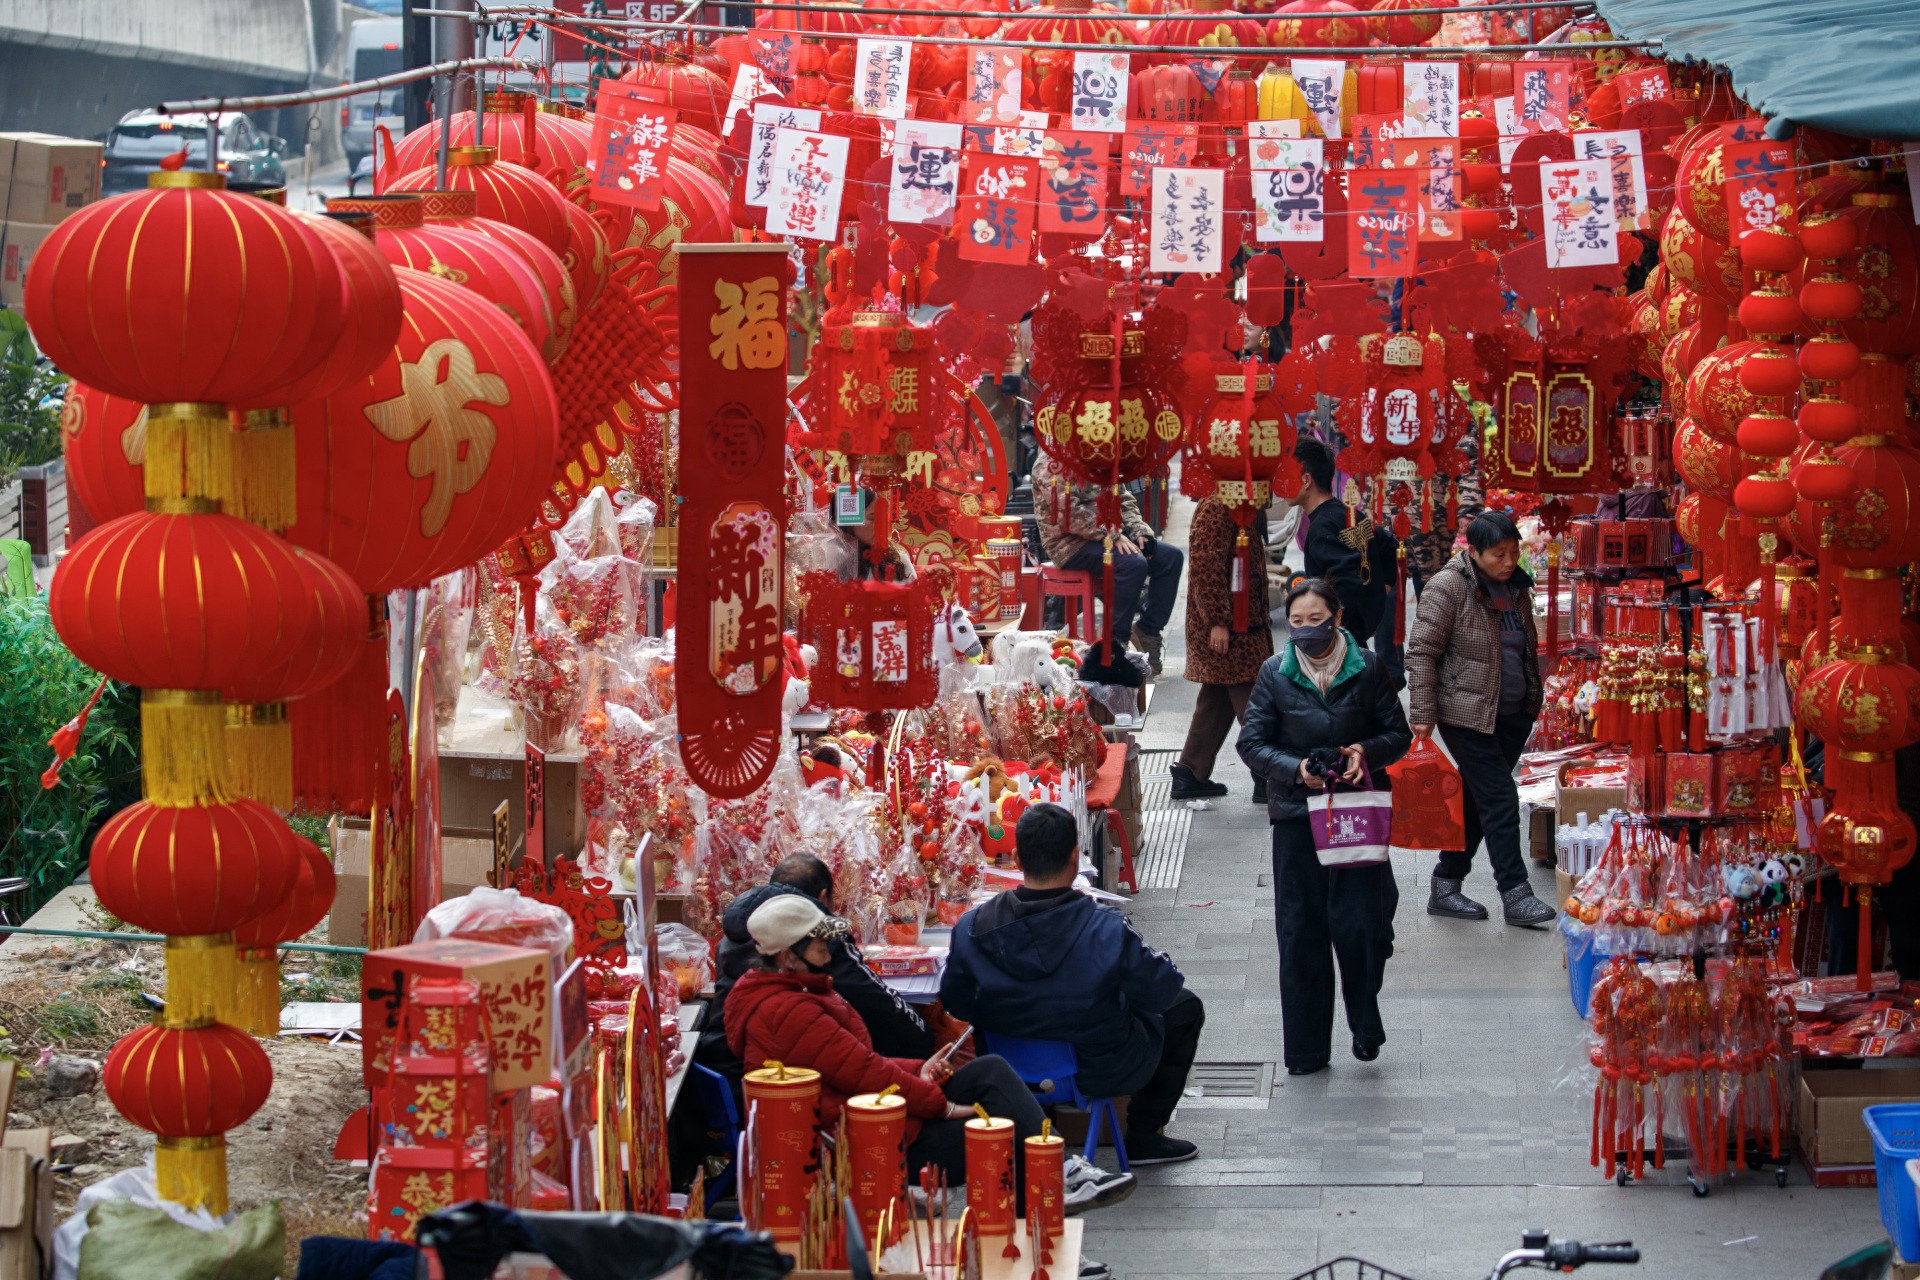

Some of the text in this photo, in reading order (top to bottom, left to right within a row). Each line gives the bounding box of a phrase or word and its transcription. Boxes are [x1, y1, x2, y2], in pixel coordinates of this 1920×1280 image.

[650, 5, 677, 21] 5F
[709, 276, 786, 371] 福
[1076, 400, 1116, 442] 福
[1249, 419, 1281, 458] 福
[1387, 394, 1421, 440] 新年
[1508, 402, 1537, 443] 福
[1549, 404, 1588, 447] 福
[708, 523, 786, 688] 新年
[873, 626, 907, 678] 吉祥
